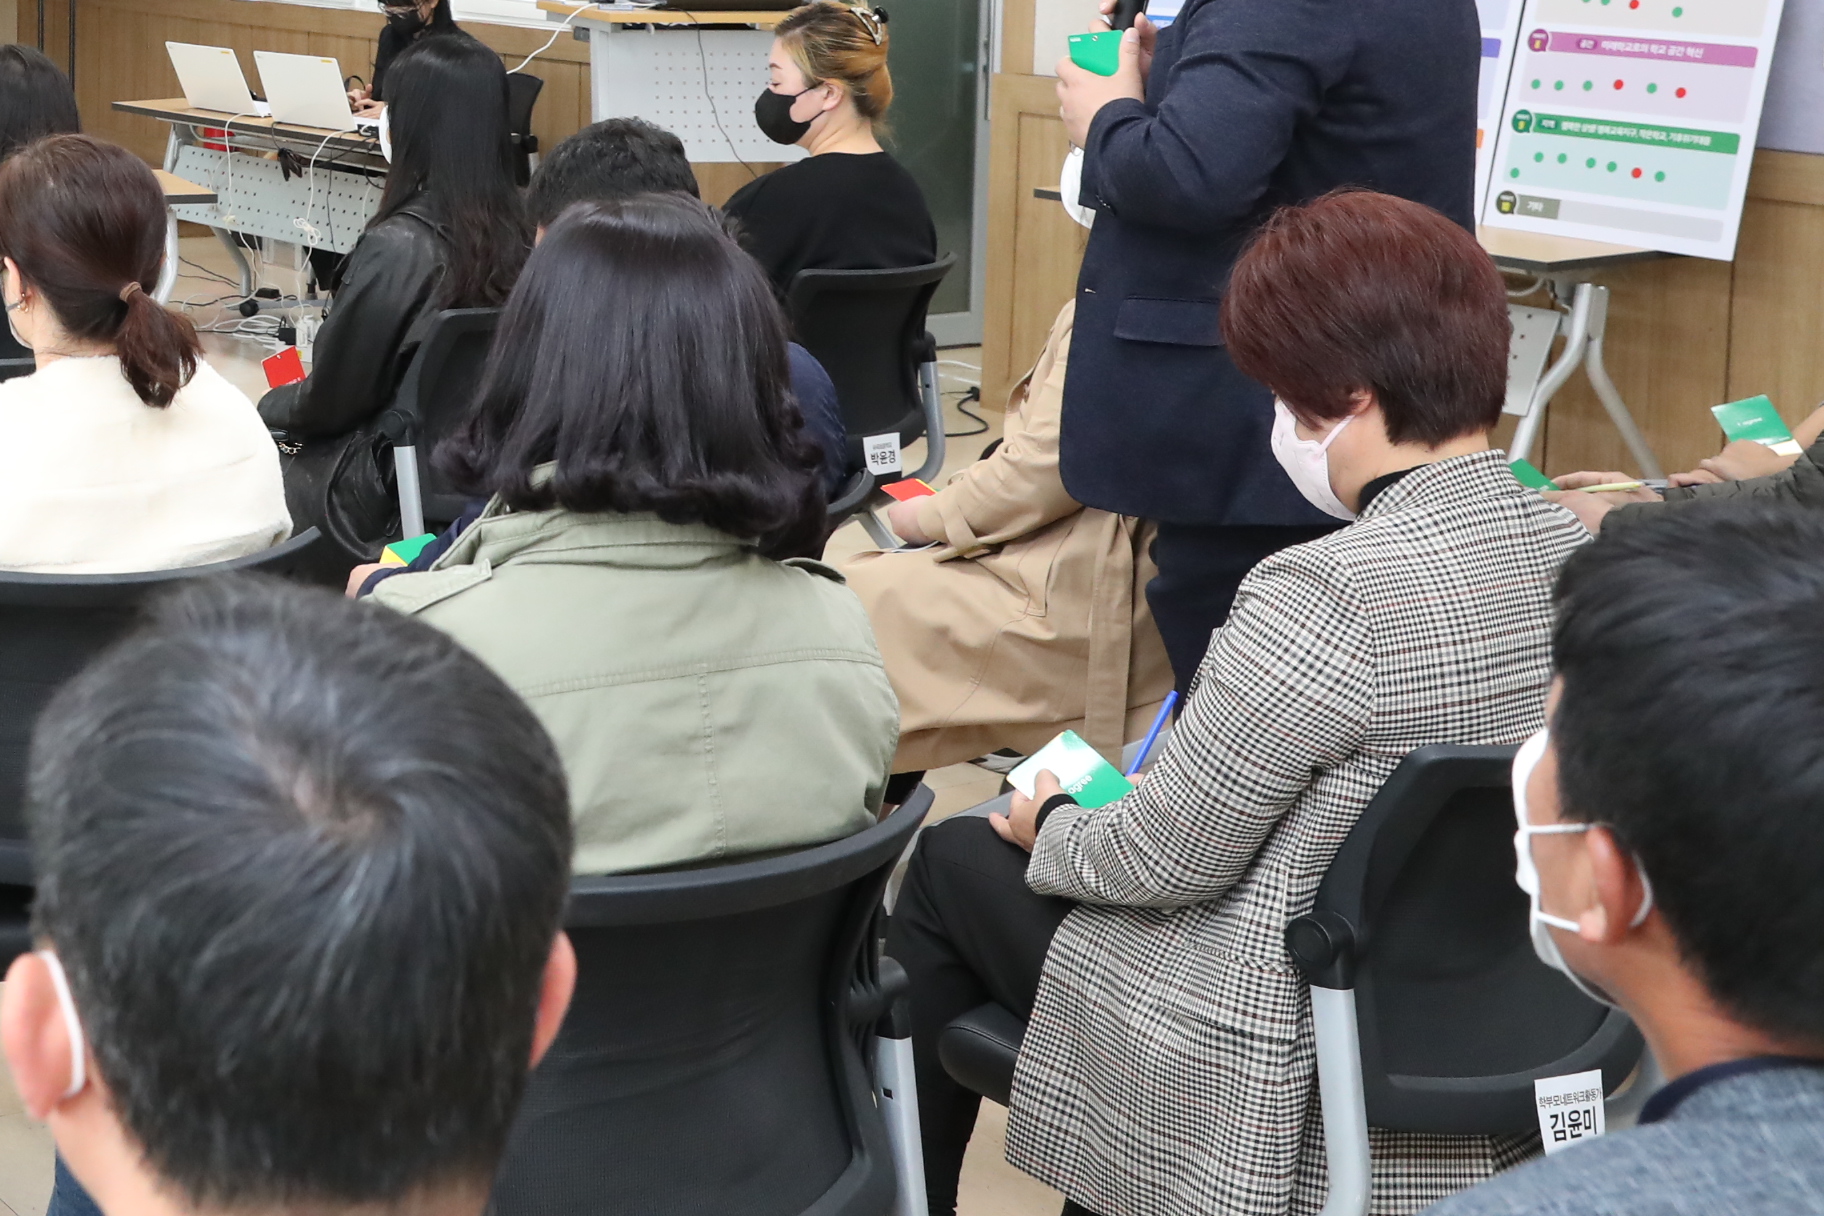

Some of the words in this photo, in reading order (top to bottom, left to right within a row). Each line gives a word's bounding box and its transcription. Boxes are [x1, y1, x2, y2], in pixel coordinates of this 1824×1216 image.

[1068, 774, 1093, 795] agree
[1538, 1087, 1603, 1110] 학부모네트워크활동가
[1550, 1105, 1598, 1143] 김윤미
